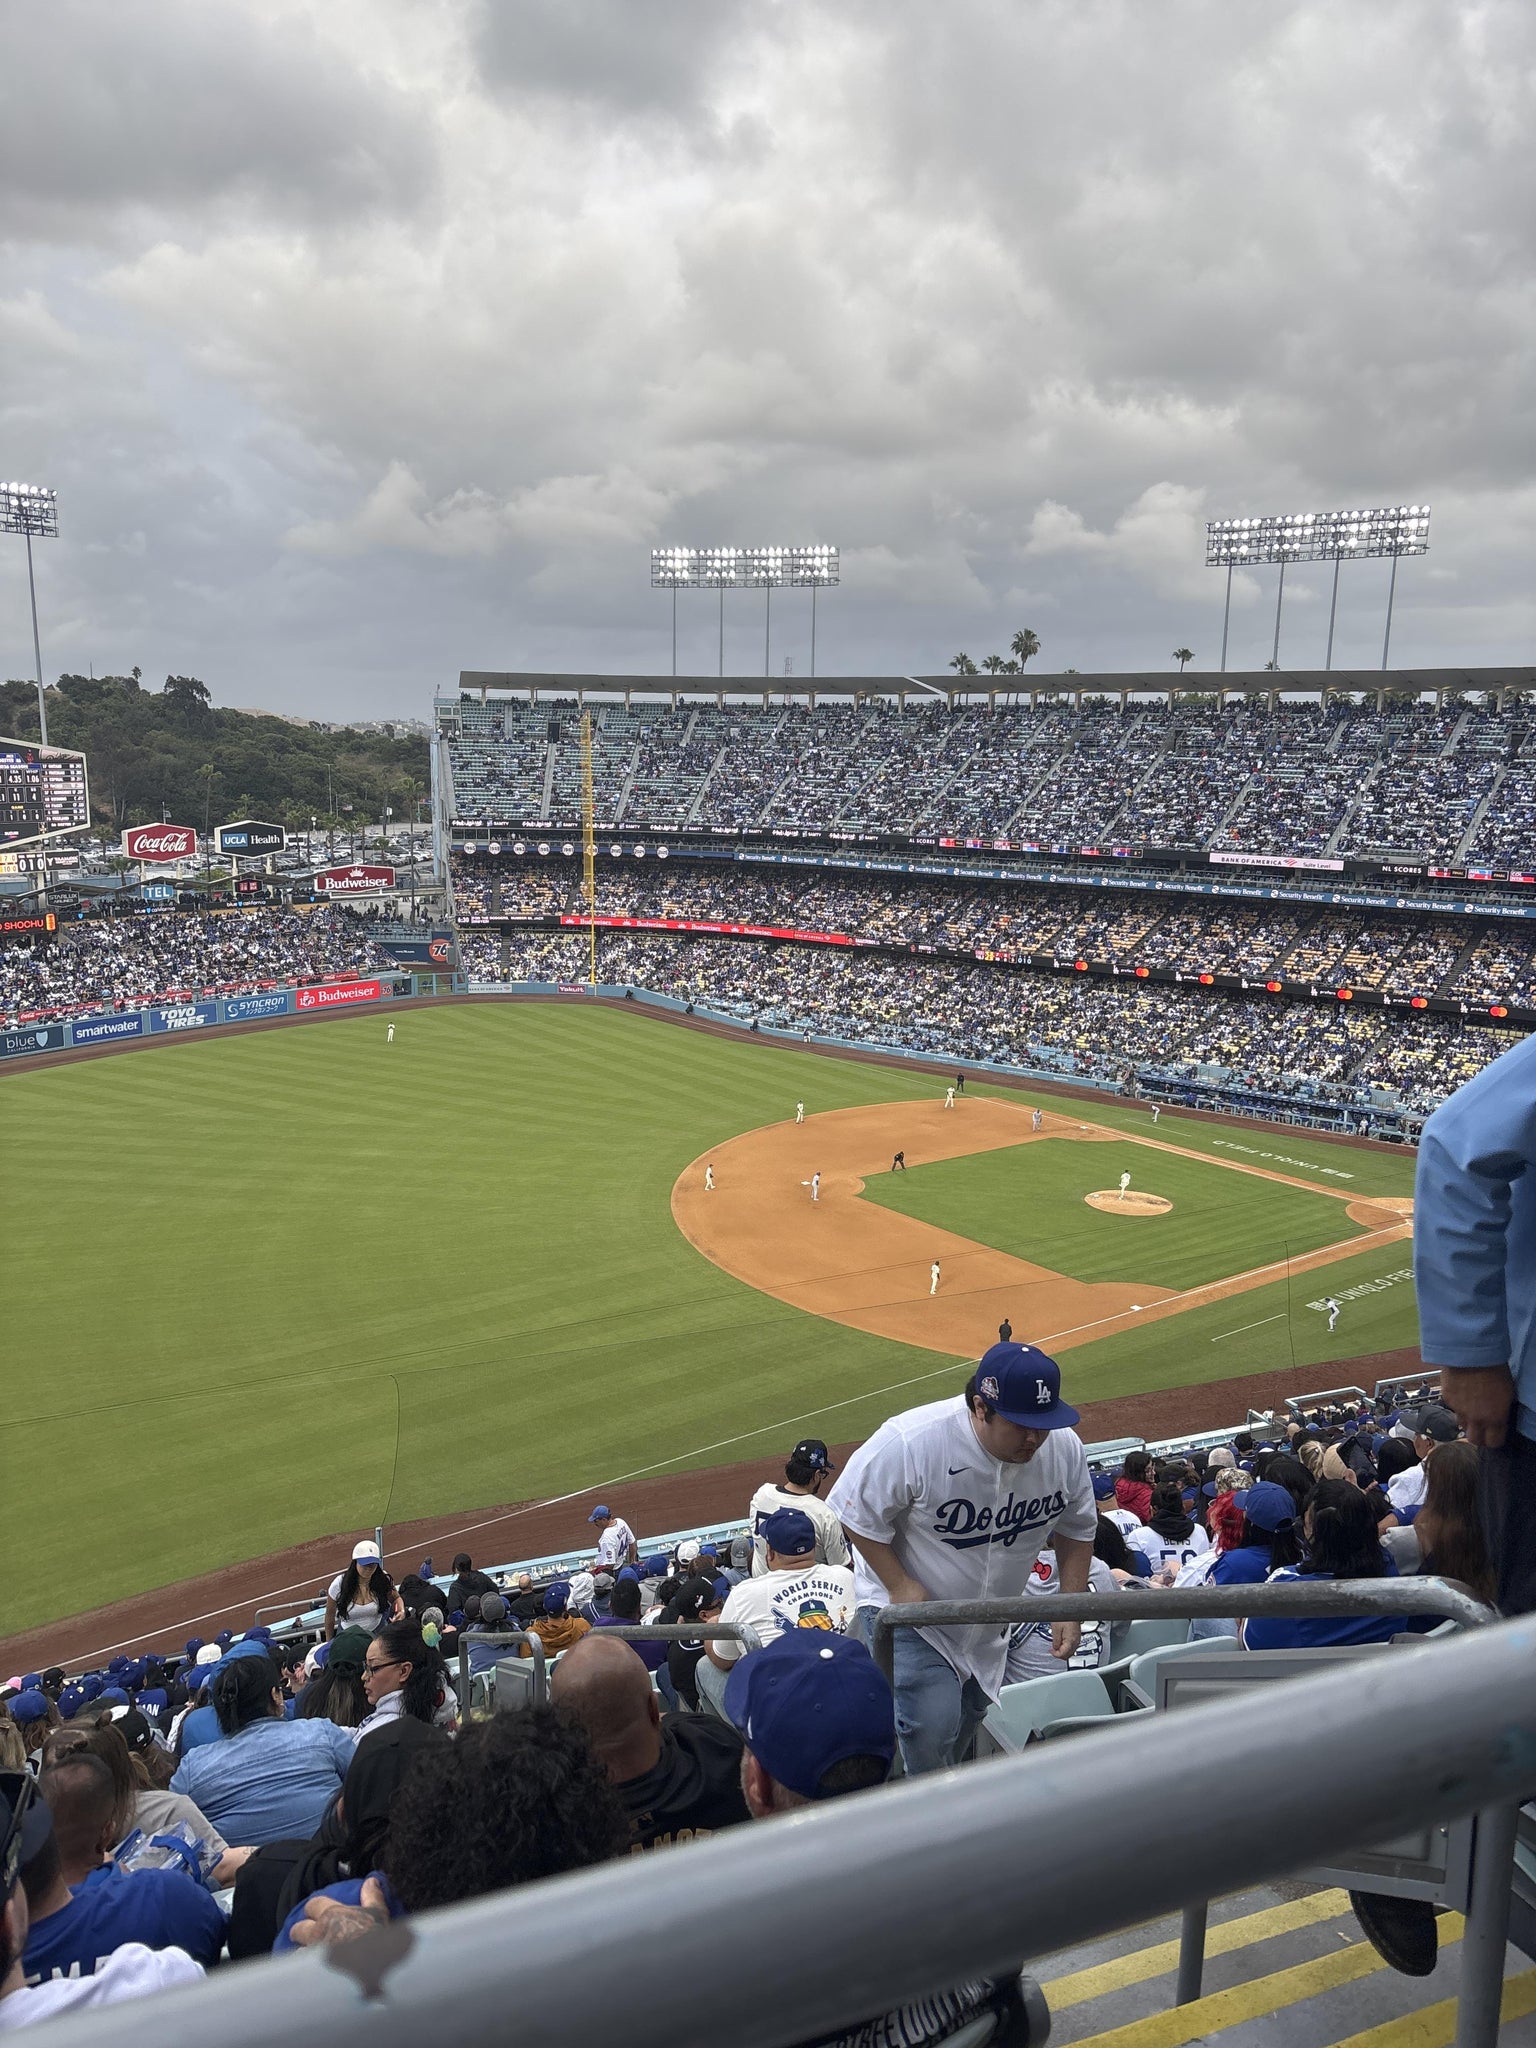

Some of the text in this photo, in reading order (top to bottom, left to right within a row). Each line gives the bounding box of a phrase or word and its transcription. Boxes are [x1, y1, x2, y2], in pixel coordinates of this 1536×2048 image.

[9, 775, 40, 783] 4.35 1.06
[133, 833, 190, 853] Coca-Cola
[224, 835, 281, 845] UCLA Health
[1394, 866, 1422, 874] SCORES
[324, 877, 388, 890] Budweiser
[1108, 879, 1128, 887] Security
[1163, 883, 1183, 891] Security
[146, 887, 170, 898] TEL
[1220, 887, 1241, 895] Security
[1279, 892, 1302, 900] Security
[1341, 896, 1365, 904] Security
[1406, 901, 1431, 910] Security
[1474, 906, 1528, 916] Security Benefit
[4, 919, 44, 930] SHOCHU
[636, 920, 668, 928] Budweiser
[743, 927, 773, 936] Budweiser
[432, 943, 449, 956] 76
[318, 987, 375, 1002] Budweiser
[559, 985, 585, 993] Yakult
[160, 1007, 196, 1020] TOYO
[166, 1014, 204, 1029] TIRES
[76, 1021, 139, 1039] smartwater
[6, 1036, 36, 1049] blue
[1212, 1140, 1319, 1170] UNIQLO FIELD
[1334, 1278, 1393, 1300] UNIQLO
[1036, 1380, 1051, 1404] LA
[933, 1490, 1066, 1547] Dodgers
[773, 1580, 844, 1603] WORLD SERIES
[788, 1591, 833, 1605] CHAMPIONS
